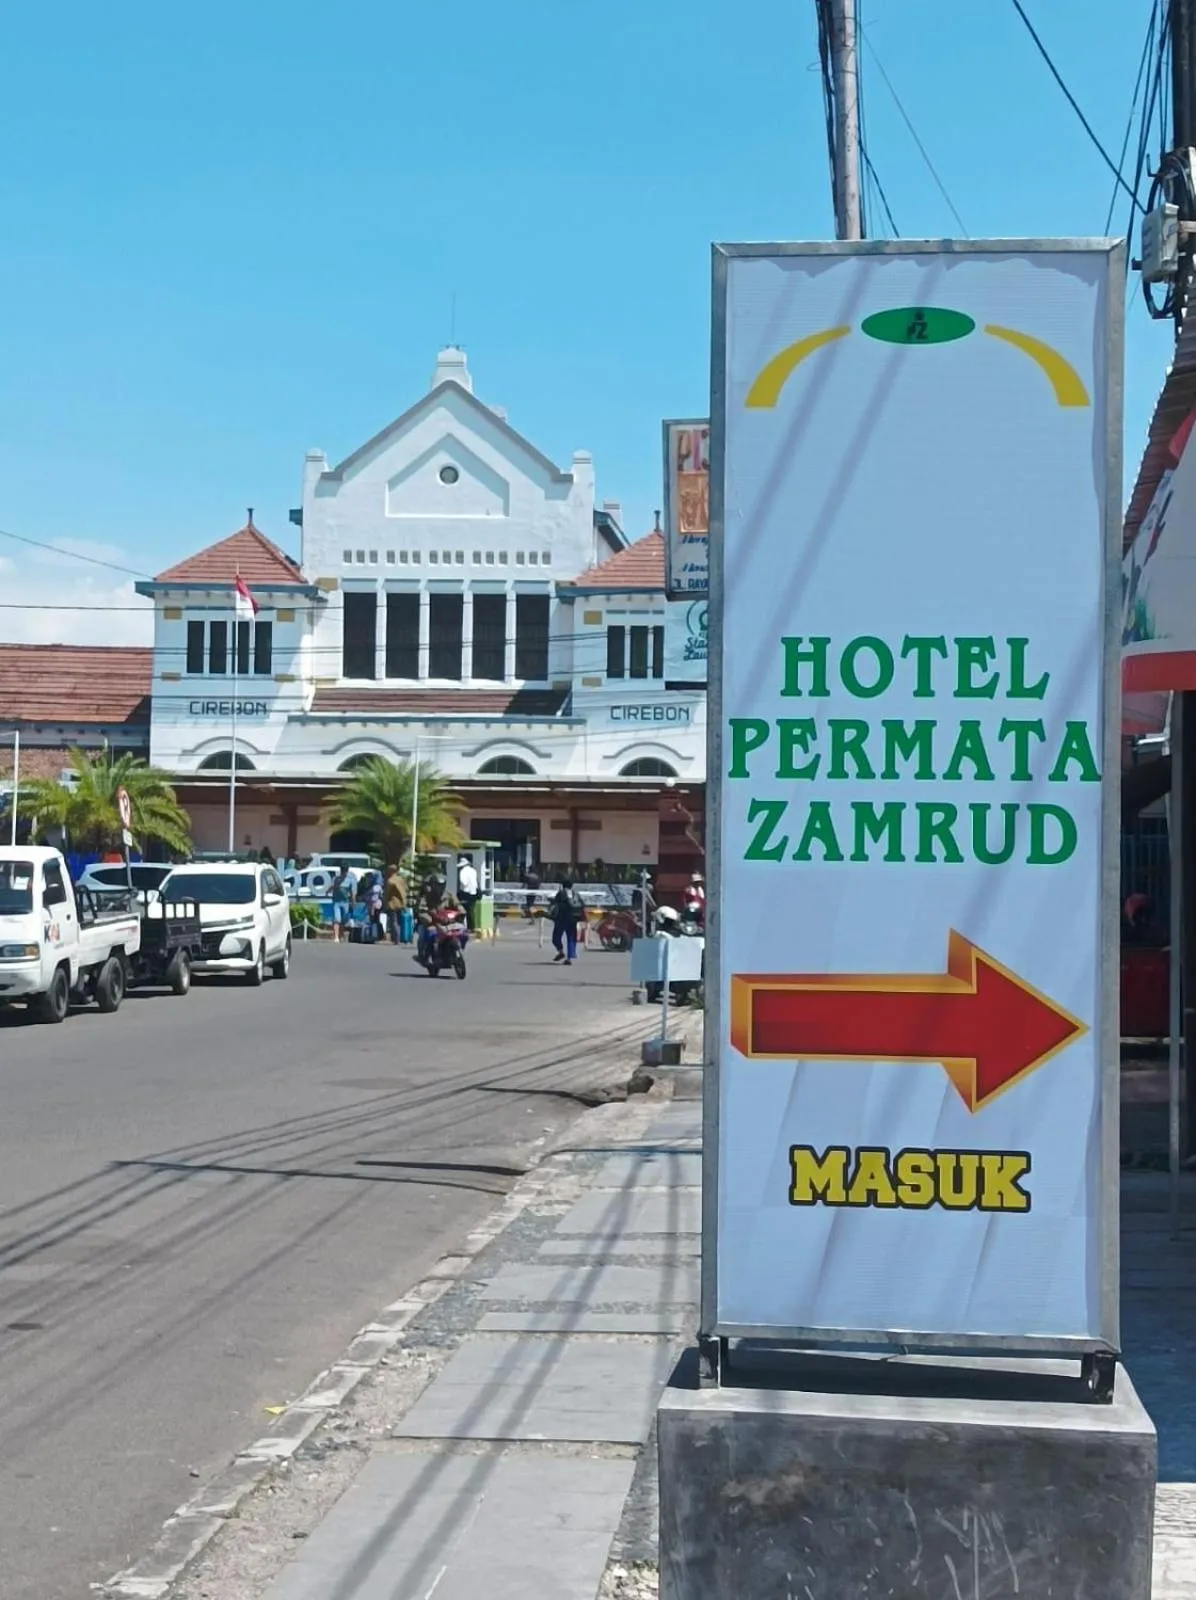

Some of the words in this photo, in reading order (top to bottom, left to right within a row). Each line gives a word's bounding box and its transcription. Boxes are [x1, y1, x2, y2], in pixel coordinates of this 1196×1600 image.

[781, 635, 1049, 699] HOTEL
[189, 701, 266, 715] CIREBON
[610, 705, 690, 721] CIREBON
[728, 717, 1102, 782] PERMATA
[744, 798, 1077, 864] ZAMRUD
[789, 1144, 1031, 1213] MASUK
